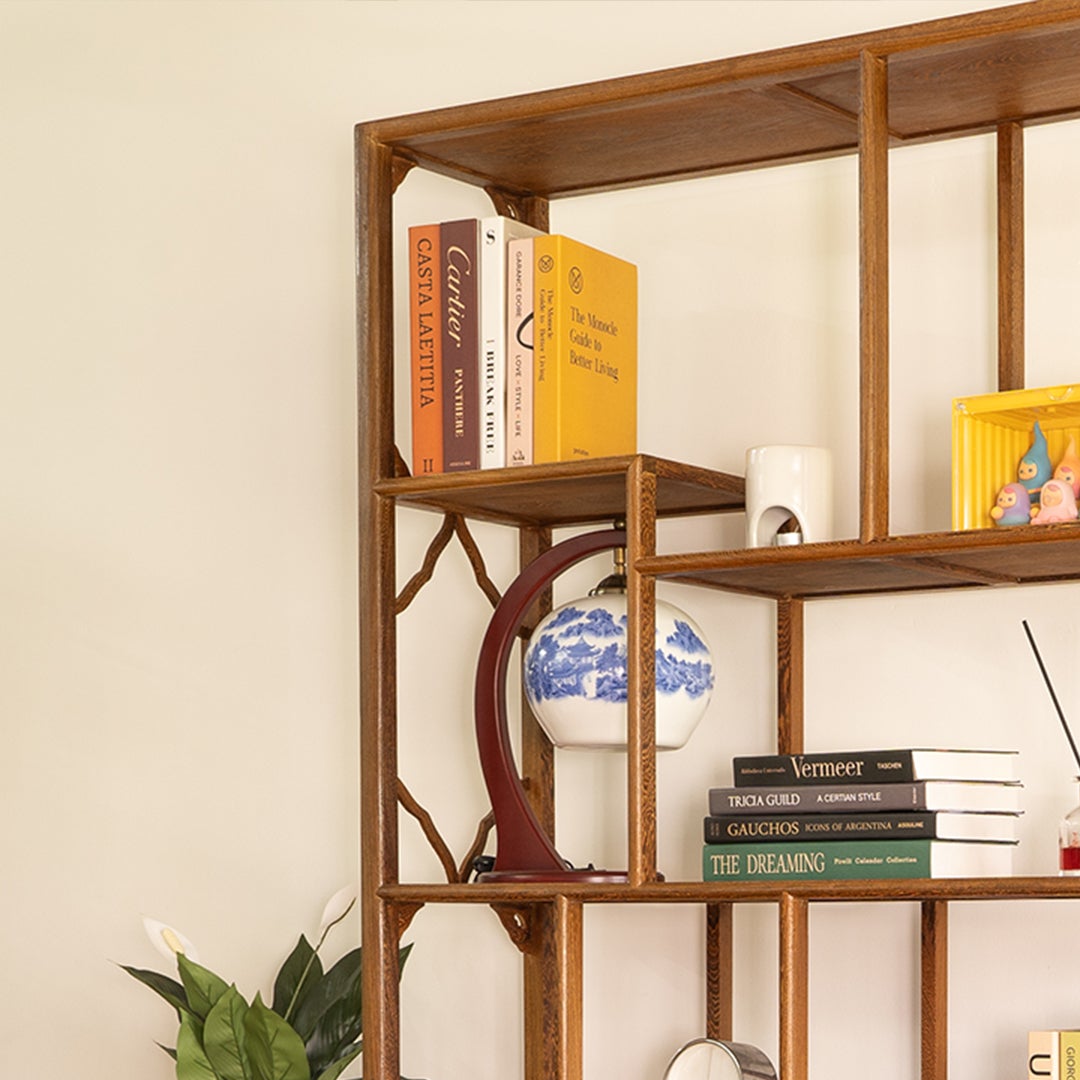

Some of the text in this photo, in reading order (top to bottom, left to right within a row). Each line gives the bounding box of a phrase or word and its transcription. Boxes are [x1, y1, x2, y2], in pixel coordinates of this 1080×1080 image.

[446, 245, 471, 349] Cartier
[417, 238, 435, 408] CASTA LAETITIA
[570, 306, 618, 336] The Monocle
[569, 328, 602, 353] Guide to
[569, 349, 619, 384] Better Living
[454, 369, 464, 438] PANTHERE
[486, 411, 495, 453] FREE
[790, 756, 864, 778] Vermeer
[728, 793, 800, 807] TRICIA GUILD
[816, 795, 823, 803] A
[857, 792, 881, 801] STYLE
[727, 821, 799, 836] GAUCHOS
[805, 821, 892, 832] ICONS OF ARGENTINA
[710, 852, 825, 875] THE DREAMING
[886, 856, 917, 864] Collection
